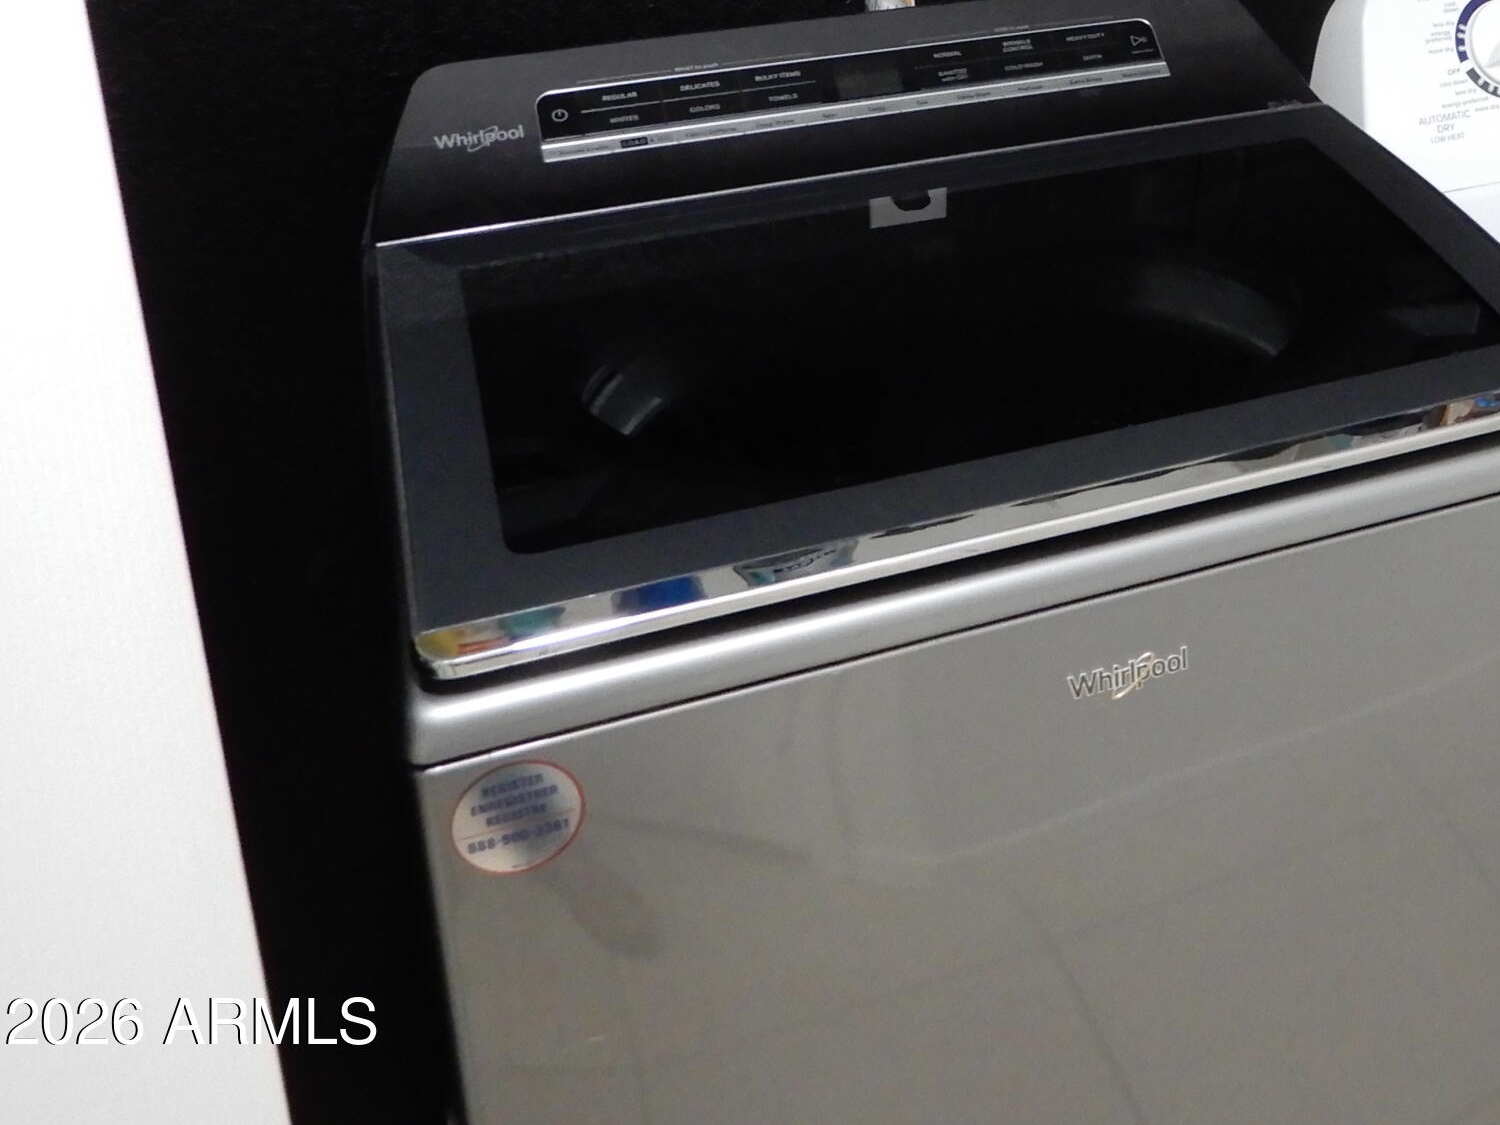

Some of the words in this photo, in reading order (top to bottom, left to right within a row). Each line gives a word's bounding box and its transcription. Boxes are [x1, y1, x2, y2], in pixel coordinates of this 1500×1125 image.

[1448, 68, 1461, 76] OFF
[679, 80, 721, 92] DELICATES
[601, 91, 638, 102] REGULAR
[768, 92, 799, 102] TOWELS
[689, 103, 721, 114] COLORS
[1418, 109, 1471, 125] AUTOMATIC
[1437, 123, 1456, 133] DRY
[432, 124, 525, 152] Whirlpool
[1066, 645, 1188, 699] Whirlpool
